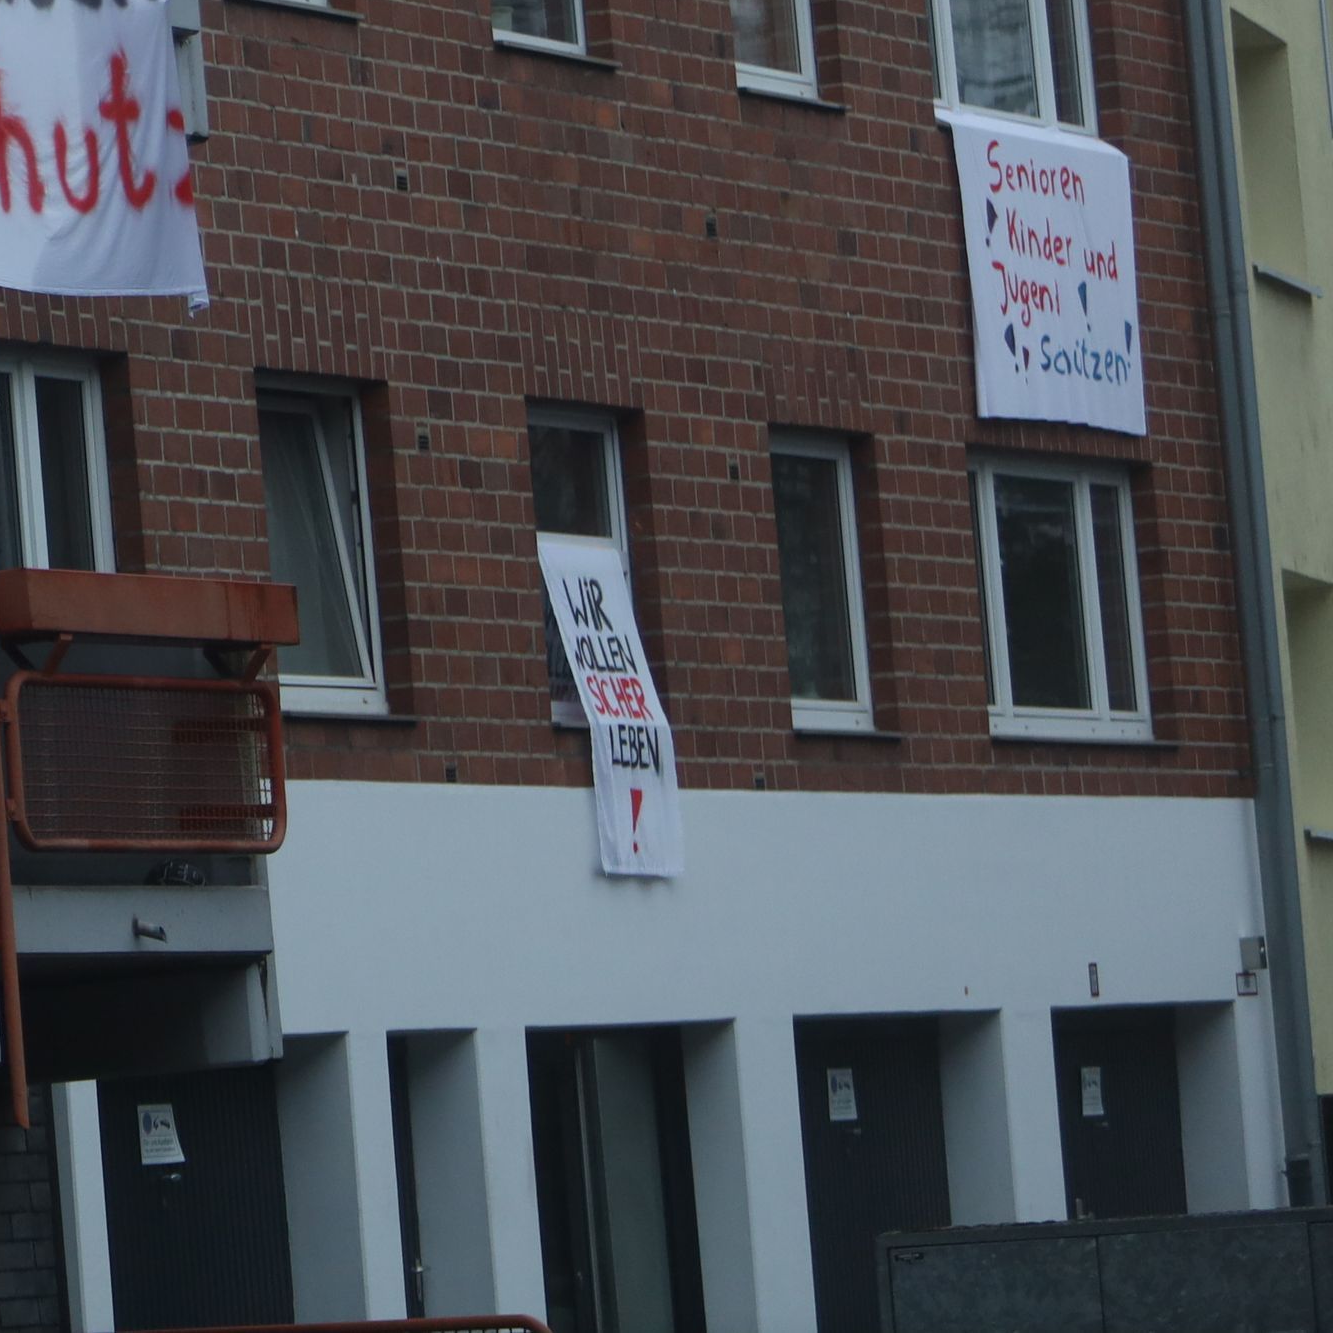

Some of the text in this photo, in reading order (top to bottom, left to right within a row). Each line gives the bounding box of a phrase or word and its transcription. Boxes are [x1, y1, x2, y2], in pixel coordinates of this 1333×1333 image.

[987, 141, 1085, 204] Senioren
[1006, 207, 1072, 266] Kinder
[1084, 240, 1118, 282] und
[586, 676, 653, 721] SICHER
[609, 724, 661, 773] LEBEN
